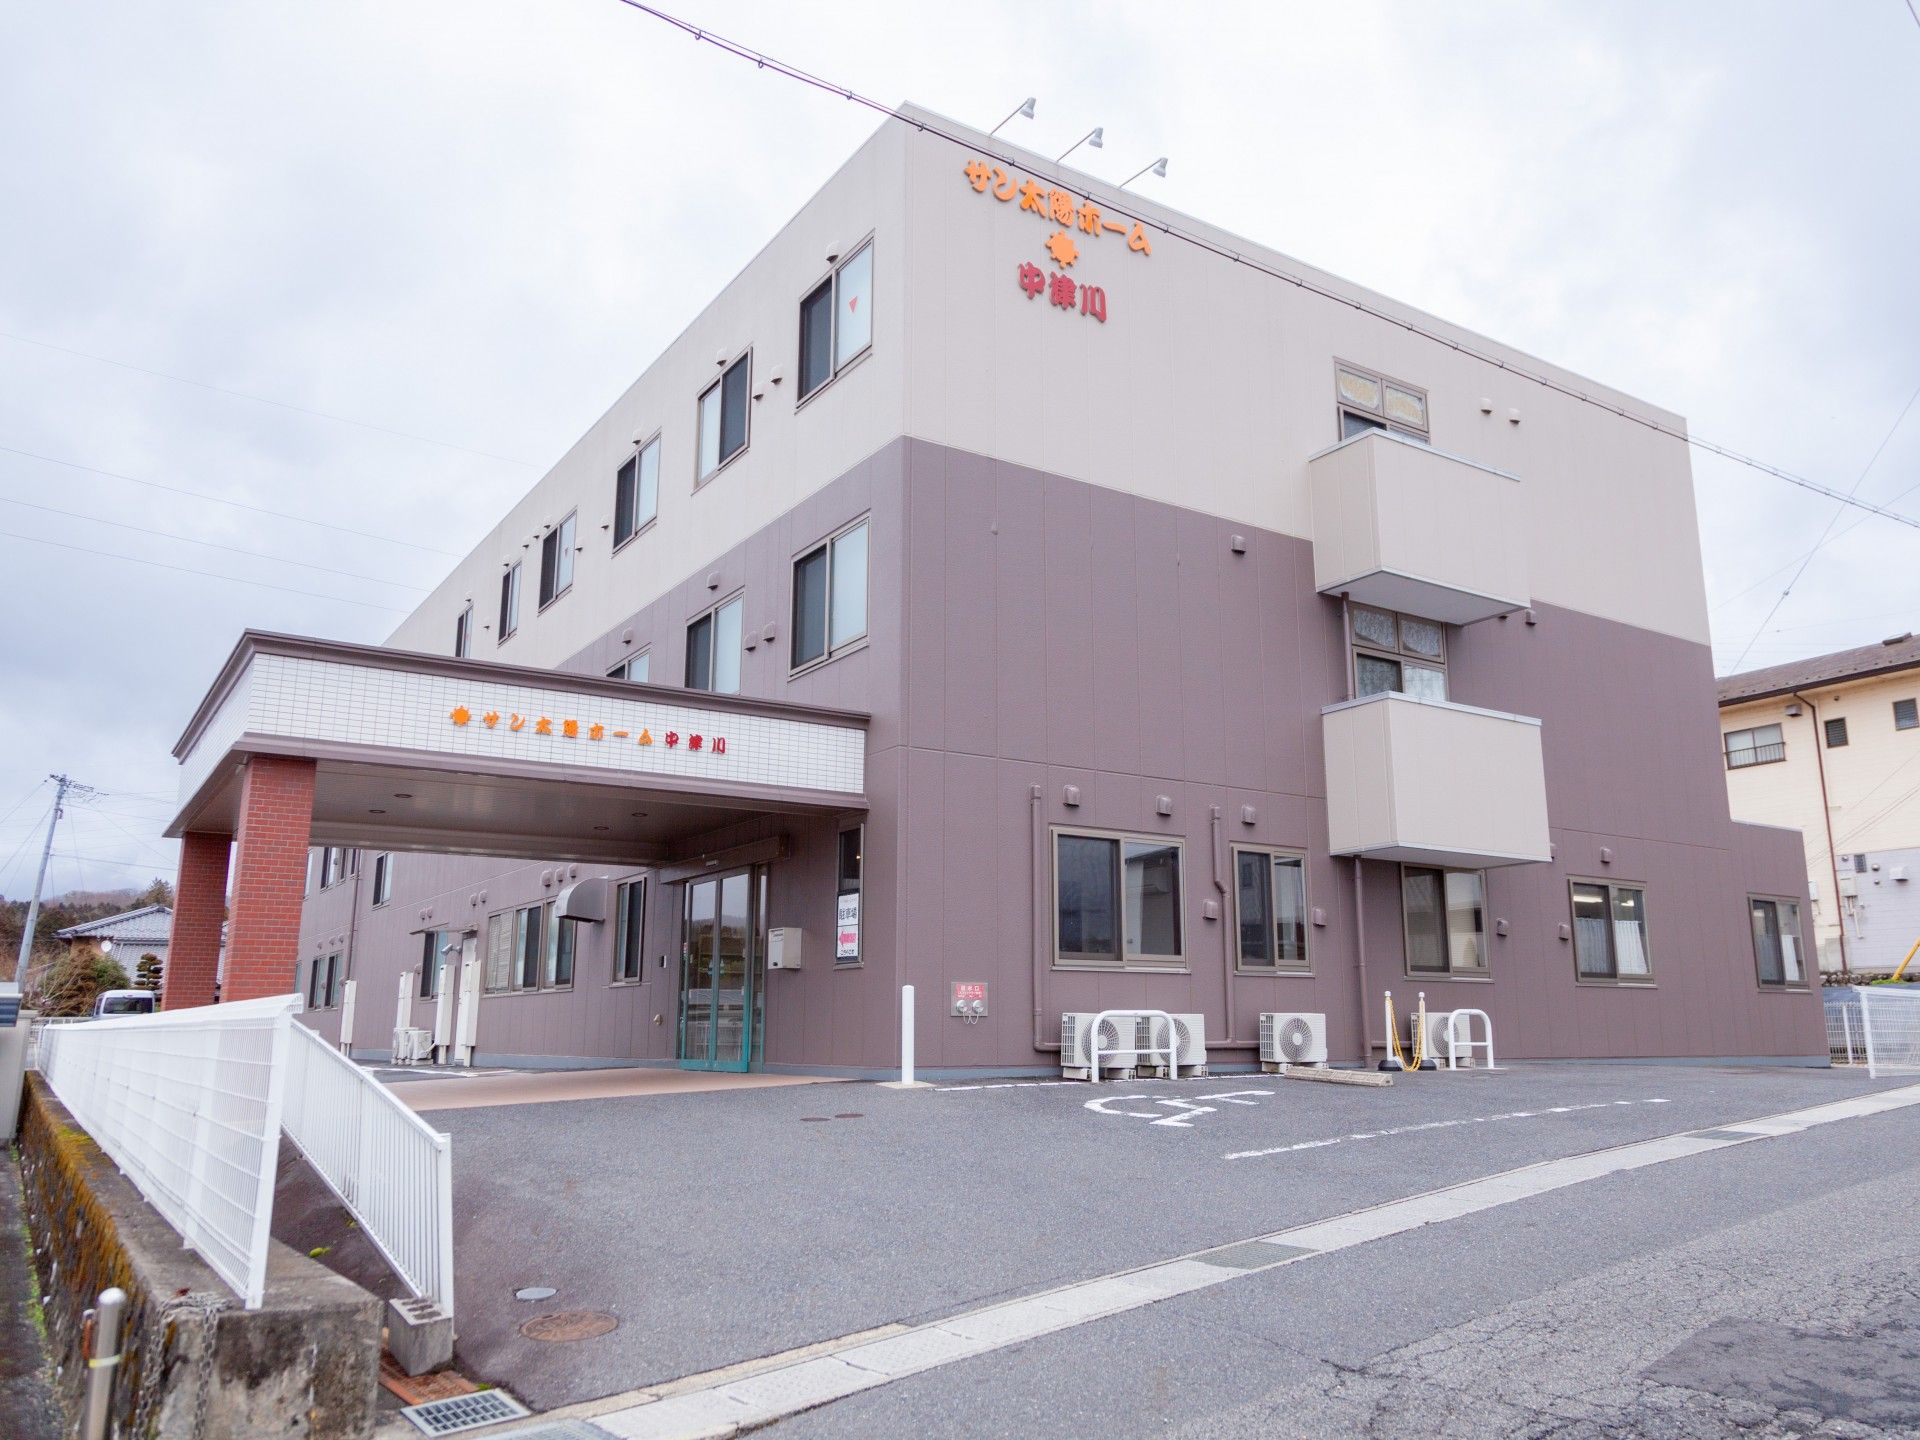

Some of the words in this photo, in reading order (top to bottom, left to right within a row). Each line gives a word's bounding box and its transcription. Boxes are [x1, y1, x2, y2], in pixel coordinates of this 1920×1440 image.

[964, 160, 1152, 256] サン太陽ホーム
[1017, 261, 1107, 323] 中津川
